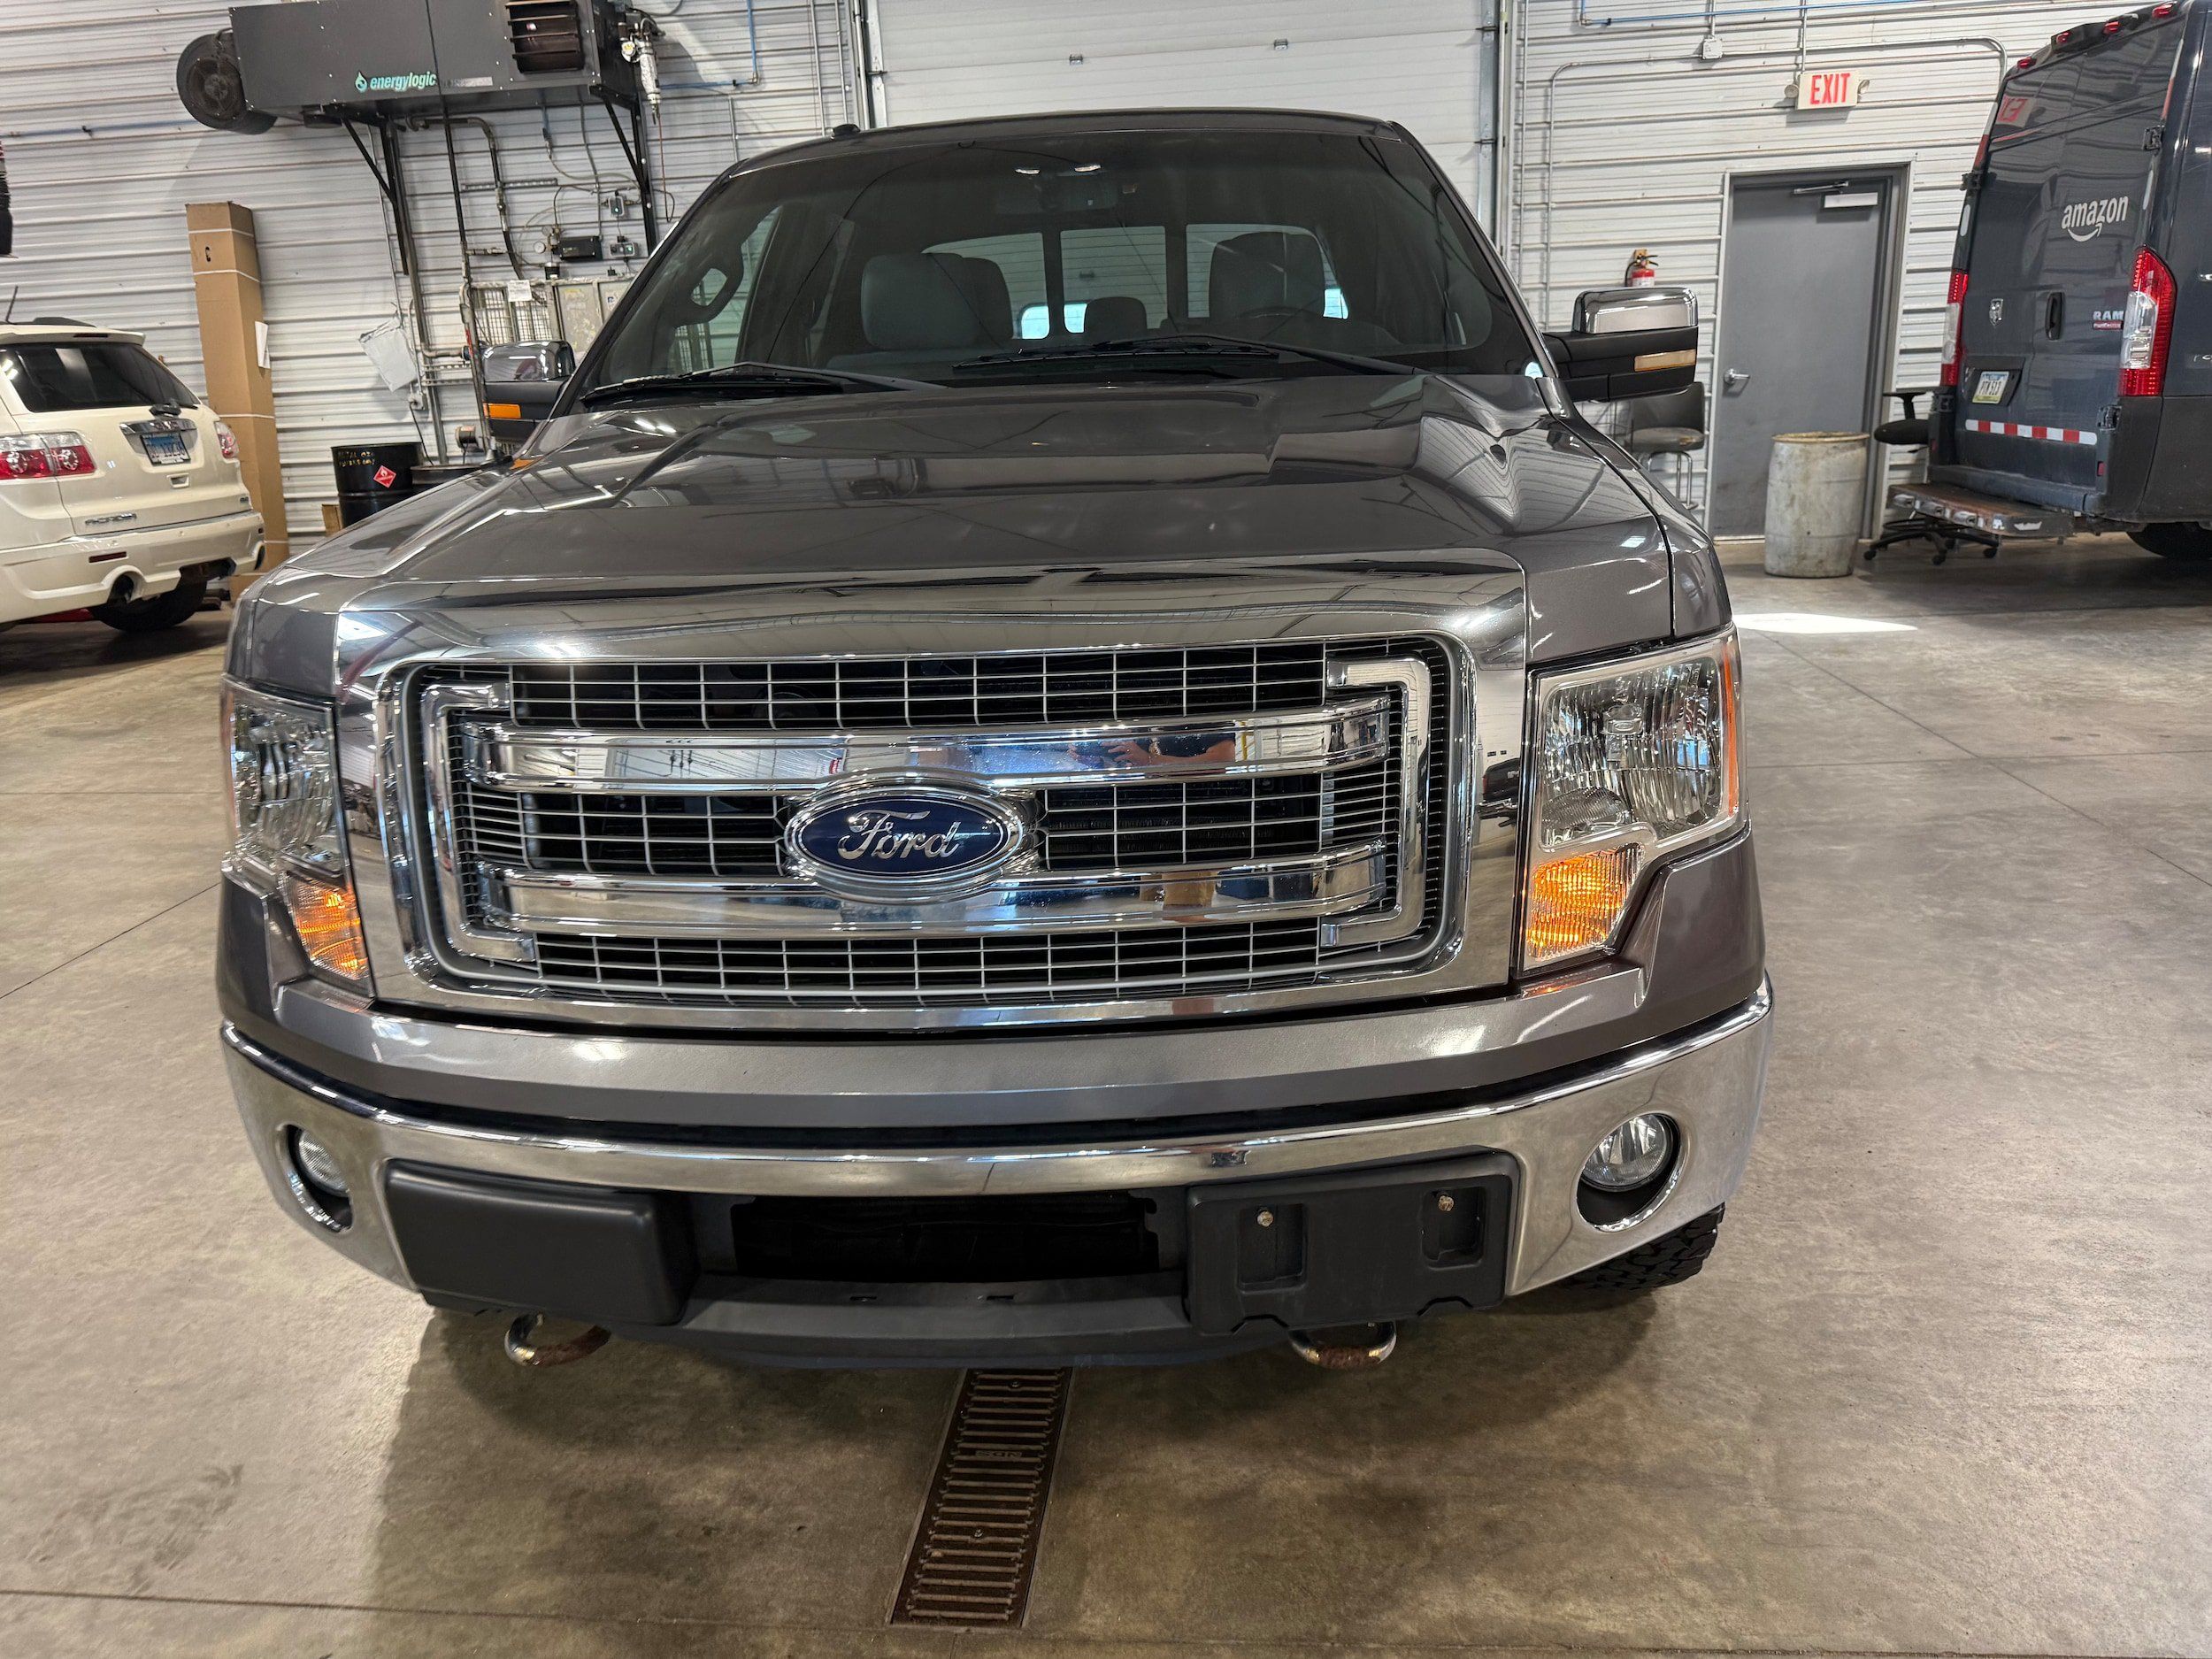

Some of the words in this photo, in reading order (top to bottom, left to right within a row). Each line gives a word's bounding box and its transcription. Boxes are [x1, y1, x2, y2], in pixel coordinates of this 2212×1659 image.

[370, 71, 437, 91] energylogic
[1810, 73, 1851, 104] EXIT
[2062, 196, 2129, 230] amazon
[2093, 311, 2124, 320] RAM
[838, 809, 962, 859] Ford
